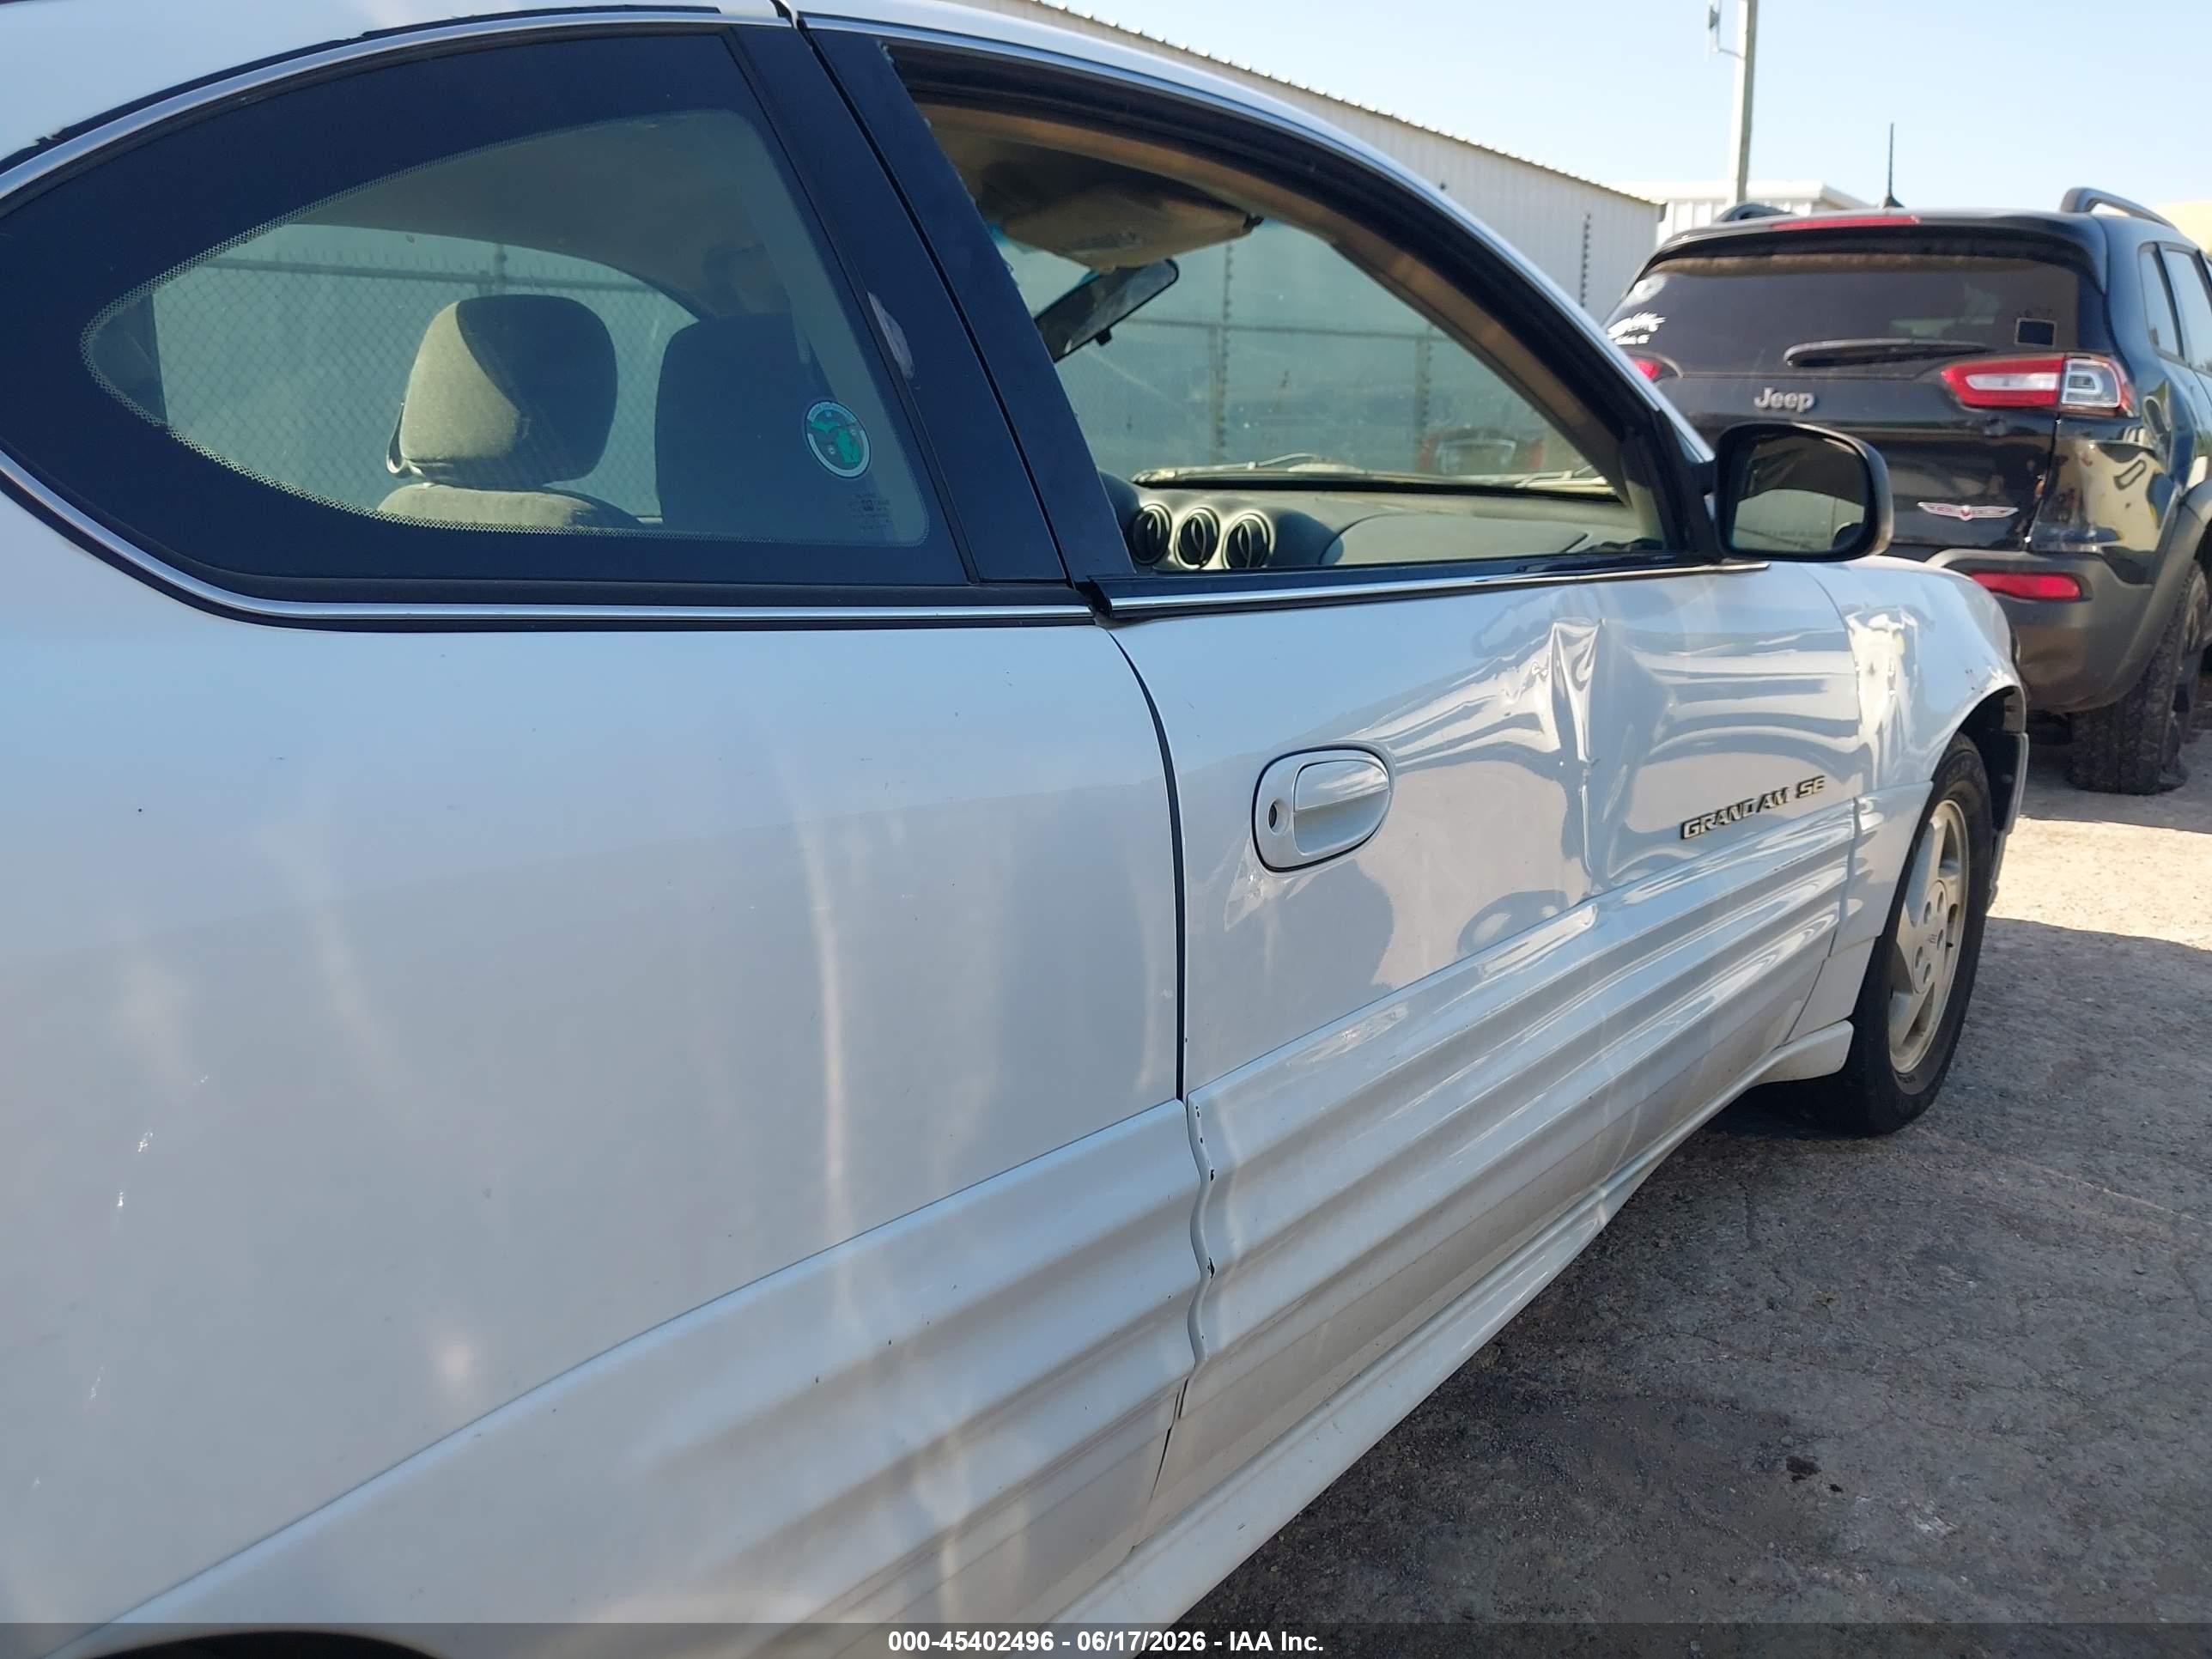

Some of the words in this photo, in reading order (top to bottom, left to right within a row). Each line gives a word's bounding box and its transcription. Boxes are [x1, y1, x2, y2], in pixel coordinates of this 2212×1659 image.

[1753, 386, 1814, 413] Jeep
[1680, 798, 1759, 840] GRAND
[1756, 786, 1796, 812] AM
[1796, 775, 1826, 799] SE
